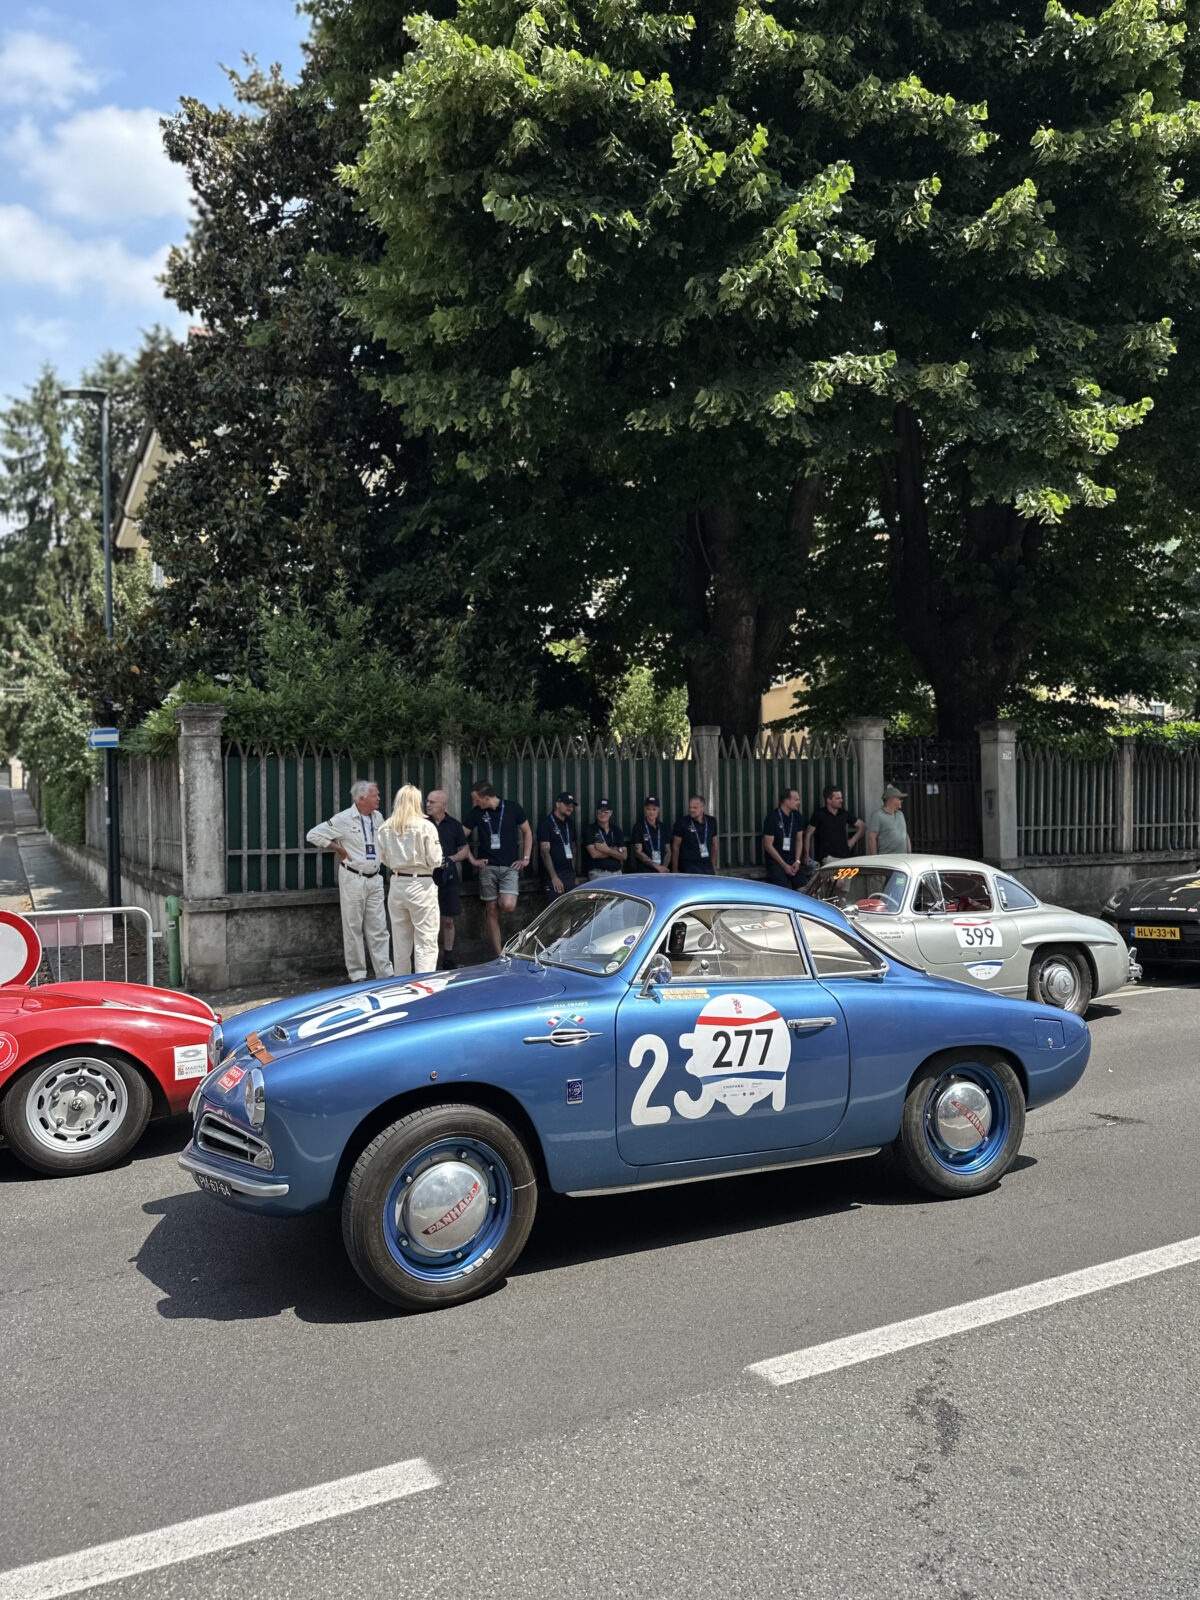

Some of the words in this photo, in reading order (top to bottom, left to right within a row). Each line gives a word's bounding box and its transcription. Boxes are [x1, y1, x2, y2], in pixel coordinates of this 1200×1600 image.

[833, 867, 860, 880] 399
[962, 927, 994, 946] 399
[1137, 928, 1176, 938] HLV-33-N
[712, 1028, 774, 1069] 277
